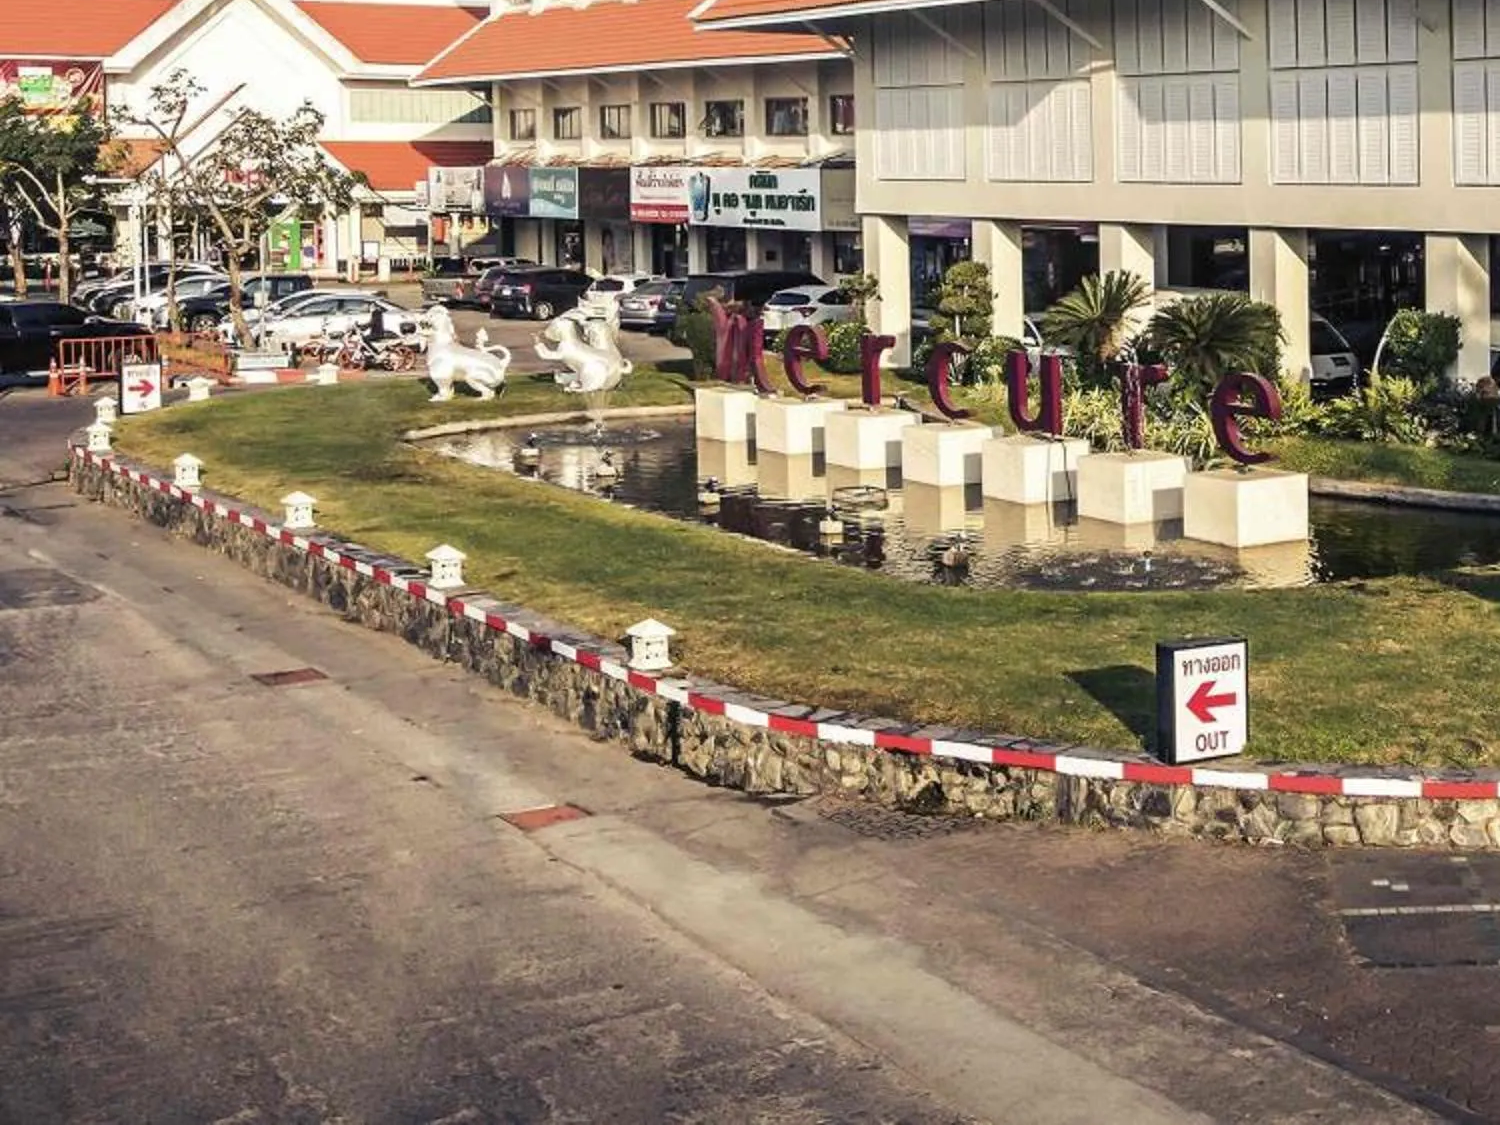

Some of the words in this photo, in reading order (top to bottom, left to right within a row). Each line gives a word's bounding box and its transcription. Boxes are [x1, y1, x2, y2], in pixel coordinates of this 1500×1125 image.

[723, 192, 740, 209] คอ
[1182, 654, 1241, 676] ทางออก
[1195, 730, 1230, 753] OUT
